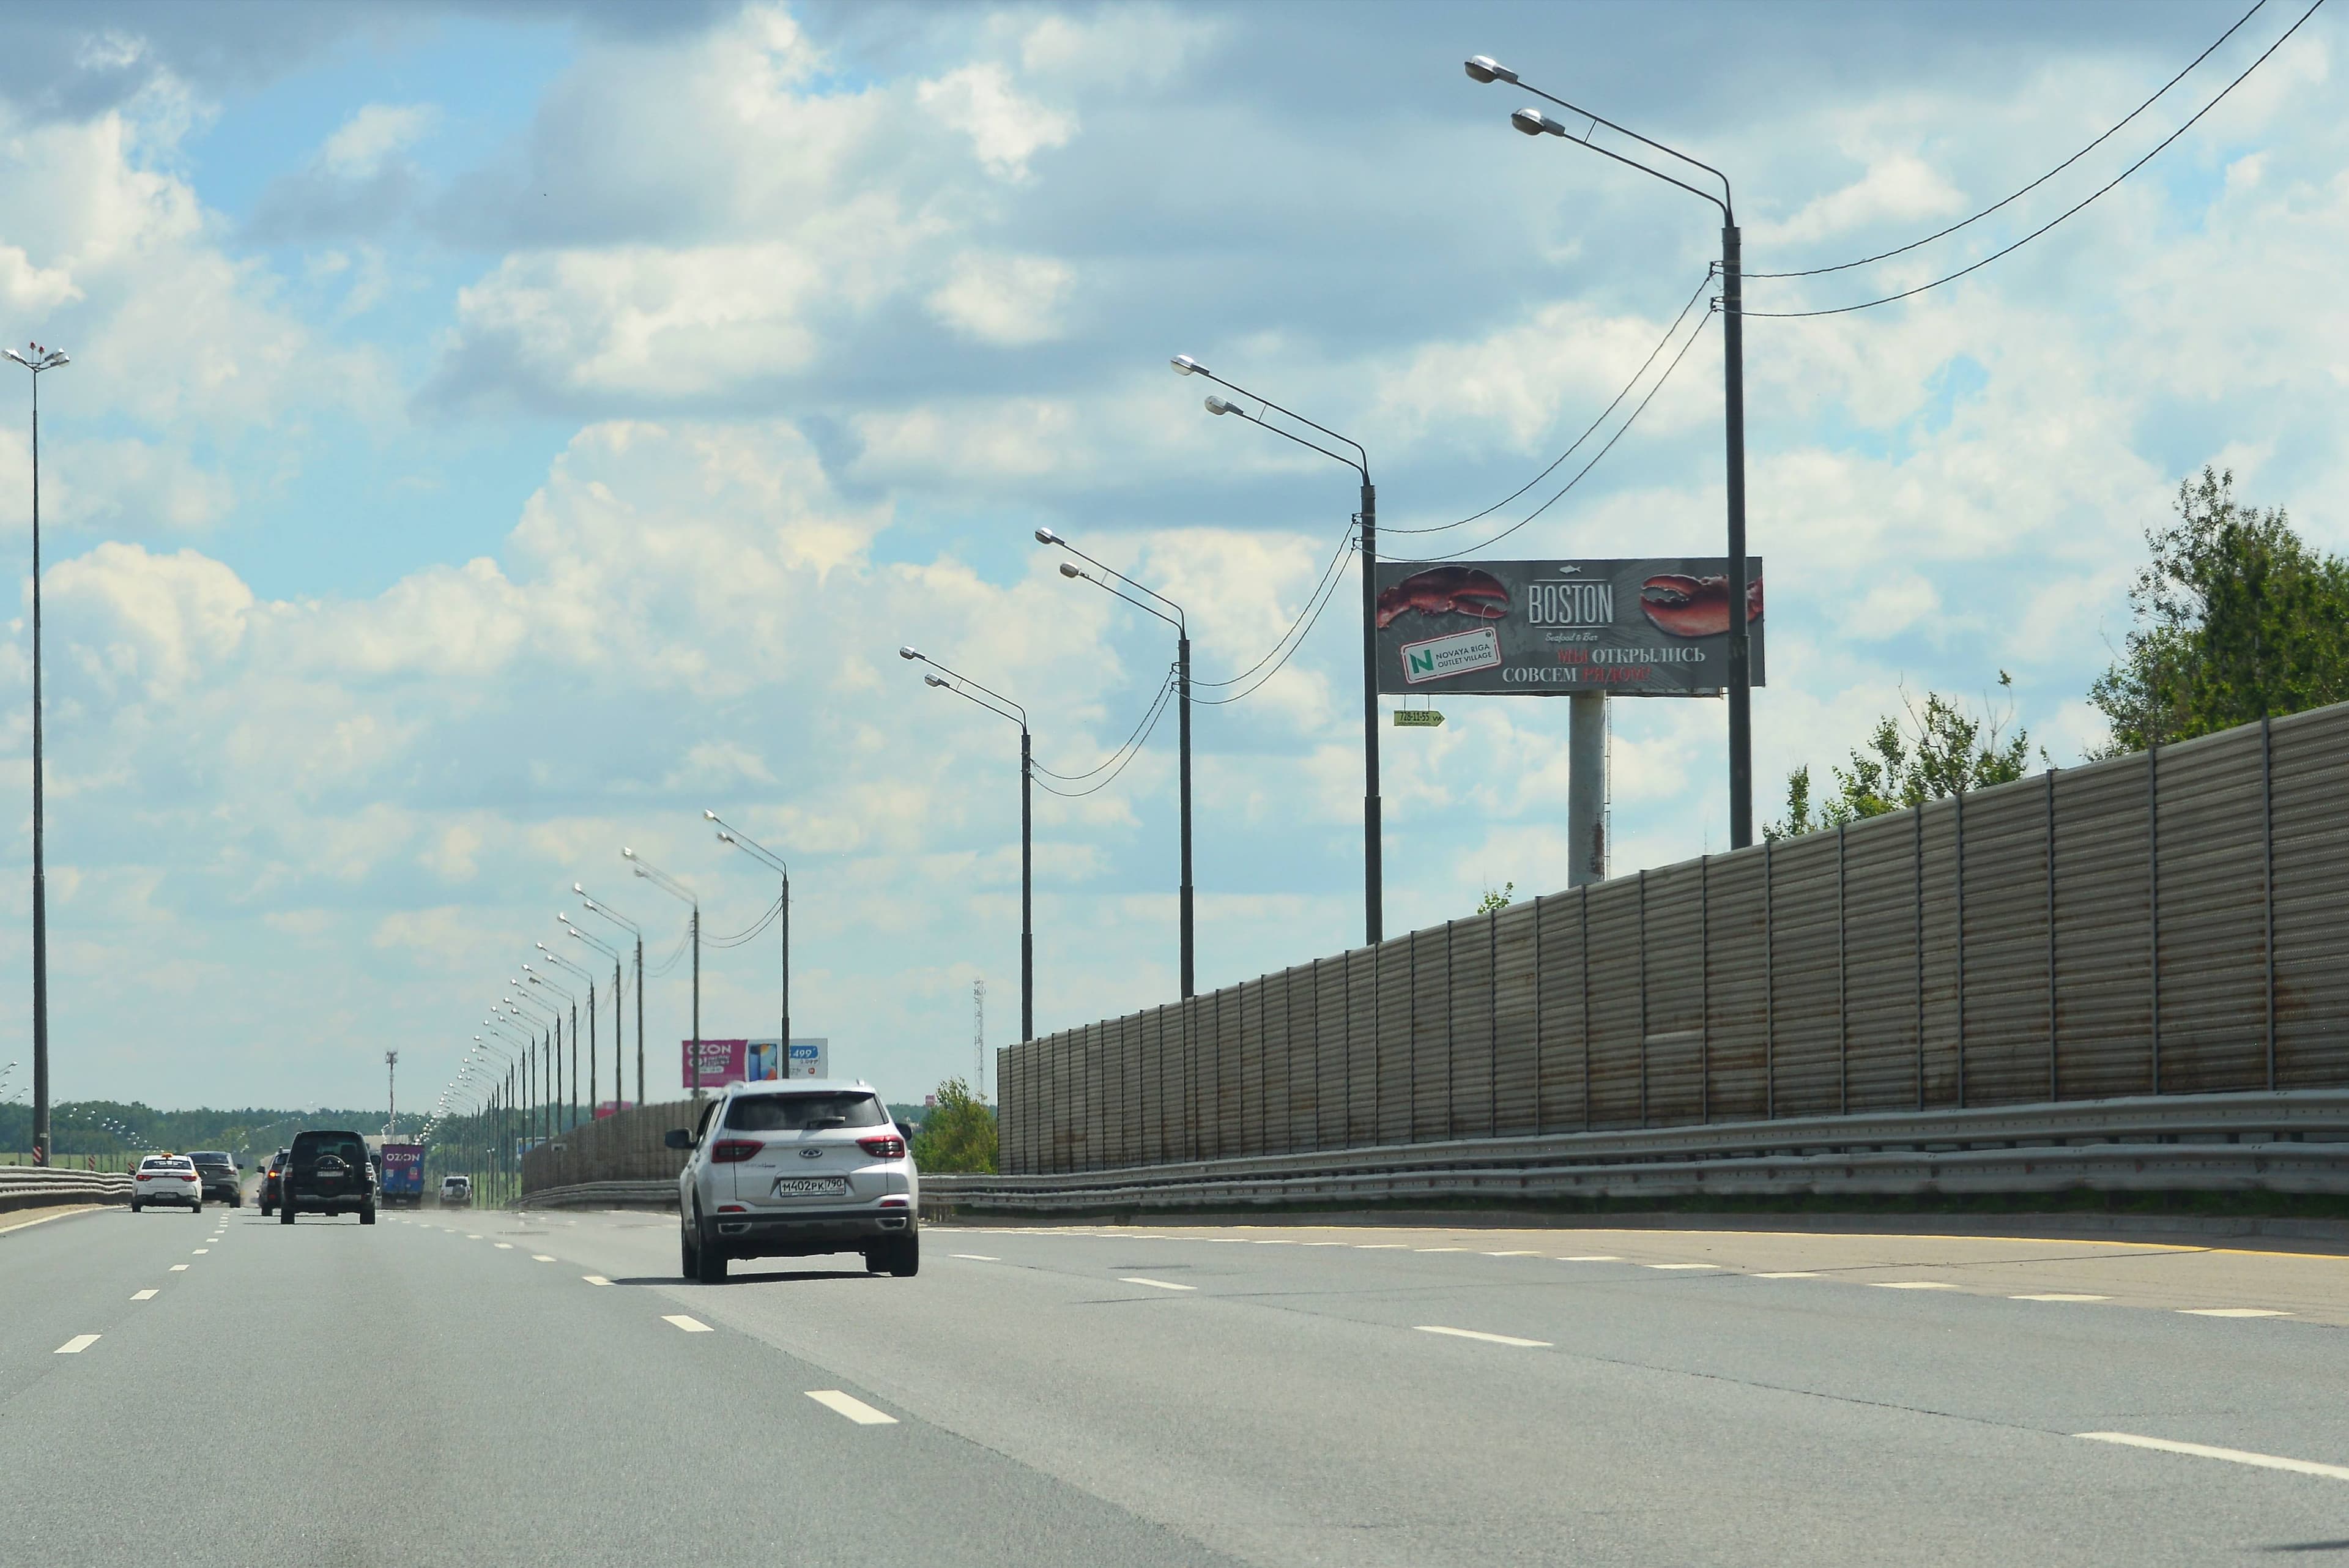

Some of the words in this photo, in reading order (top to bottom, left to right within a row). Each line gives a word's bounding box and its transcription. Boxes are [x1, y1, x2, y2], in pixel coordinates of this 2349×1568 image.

[1529, 585, 1613, 623] BOSTON
[1545, 633, 1575, 642] Seafood
[1583, 632, 1598, 641] Bar
[1436, 648, 1469, 660] NOVAYA
[1471, 644, 1490, 653] RIGA
[1438, 658, 1463, 668] OUTLET
[1463, 652, 1492, 662] VILLAGE
[1592, 647, 1705, 663] ОТКРЫЛИСЬ
[1502, 667, 1576, 682] СОВСЕМ
[826, 1179, 842, 1188] 790
